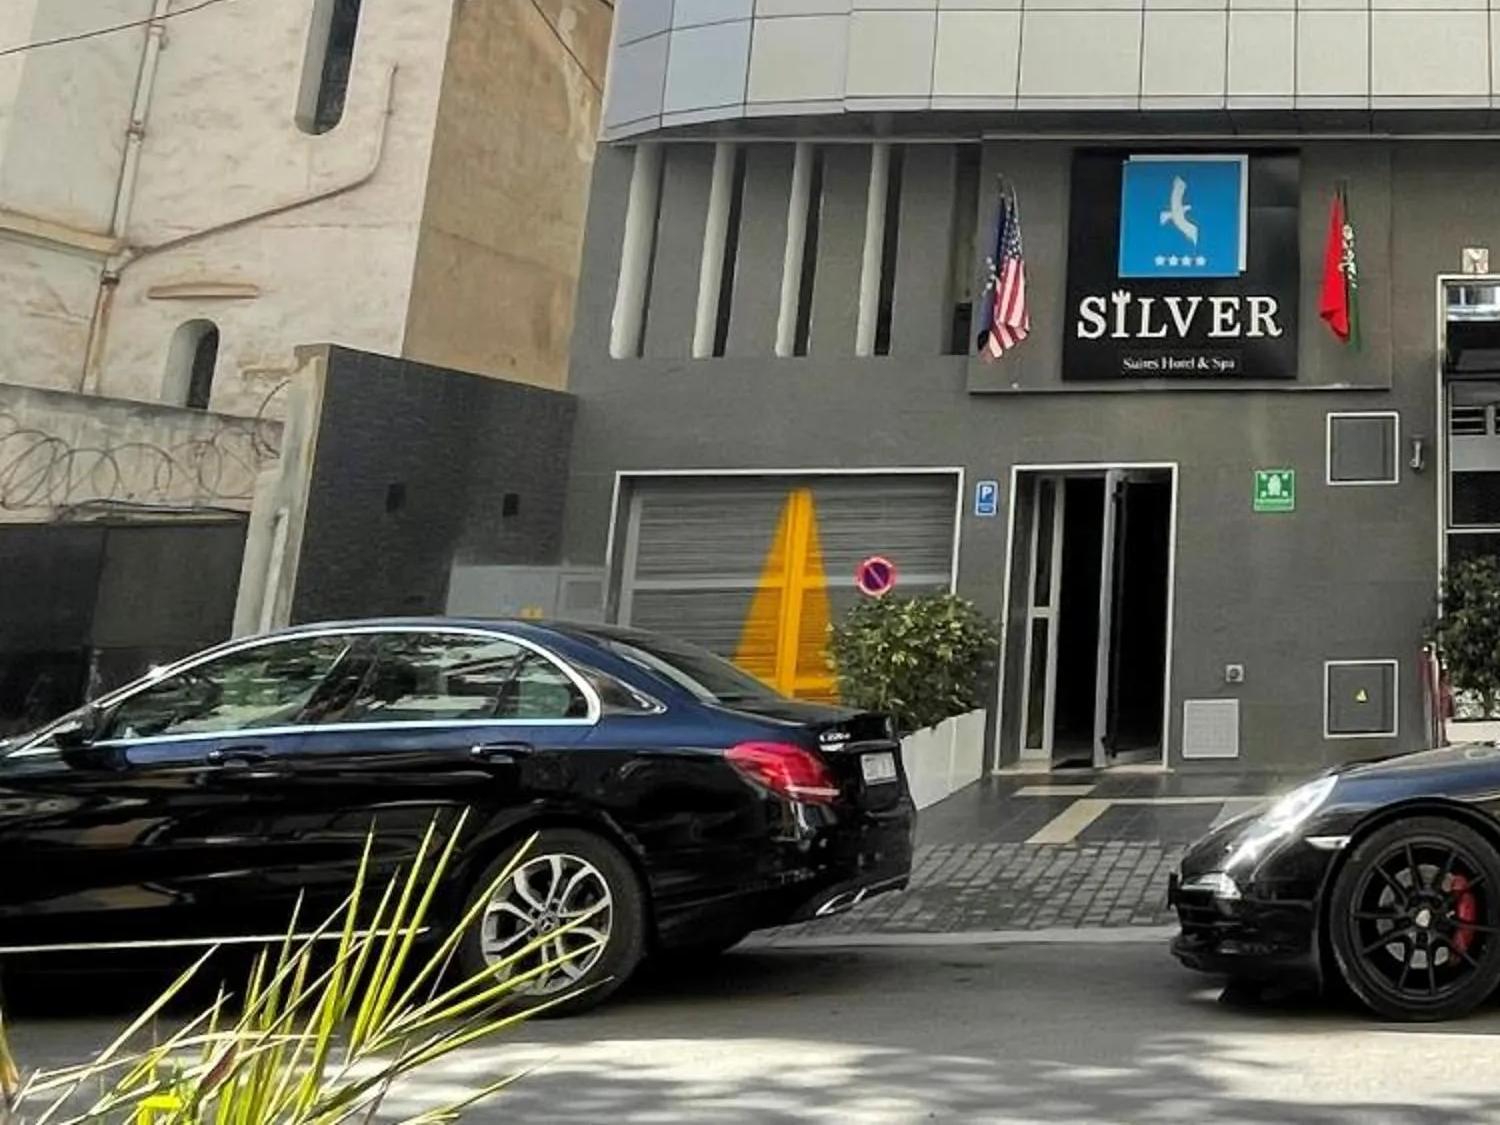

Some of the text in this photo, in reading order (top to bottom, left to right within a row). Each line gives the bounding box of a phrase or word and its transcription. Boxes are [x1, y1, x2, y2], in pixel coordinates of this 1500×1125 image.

[1077, 289, 1283, 339] SILVER
[1161, 357, 1195, 370] Hotel
[1197, 357, 1211, 369] &
[1212, 357, 1236, 372] Spa
[982, 486, 993, 500] P
